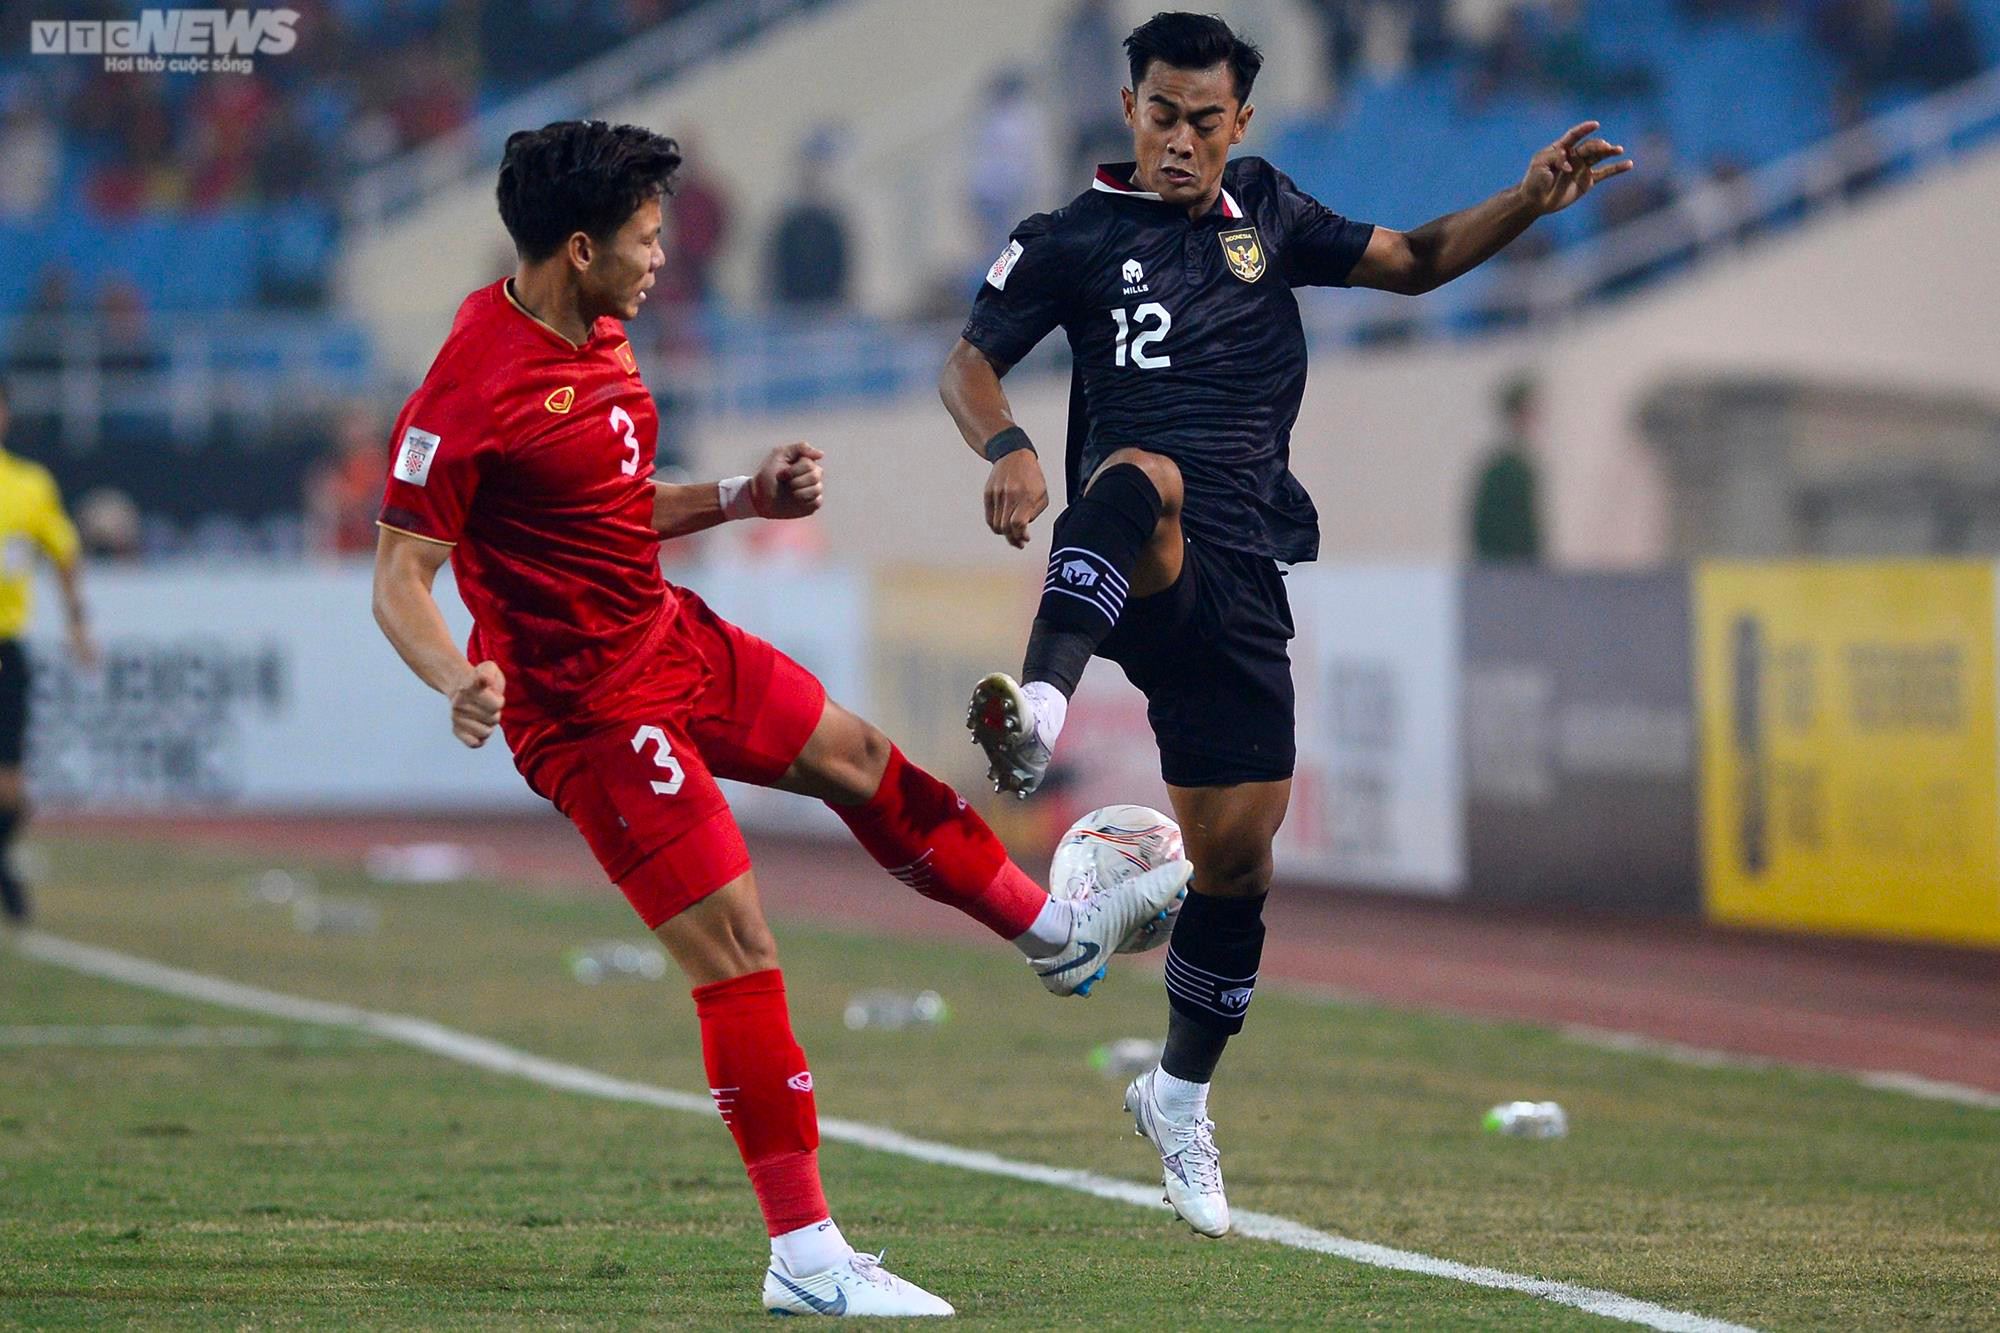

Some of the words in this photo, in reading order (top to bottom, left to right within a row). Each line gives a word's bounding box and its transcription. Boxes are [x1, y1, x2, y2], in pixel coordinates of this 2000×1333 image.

[1226, 233, 1252, 243] INDONESIA
[1123, 284, 1149, 295] MILLS
[1111, 302, 1172, 369] 12
[609, 405, 640, 476] 3
[631, 725, 686, 795] 3
